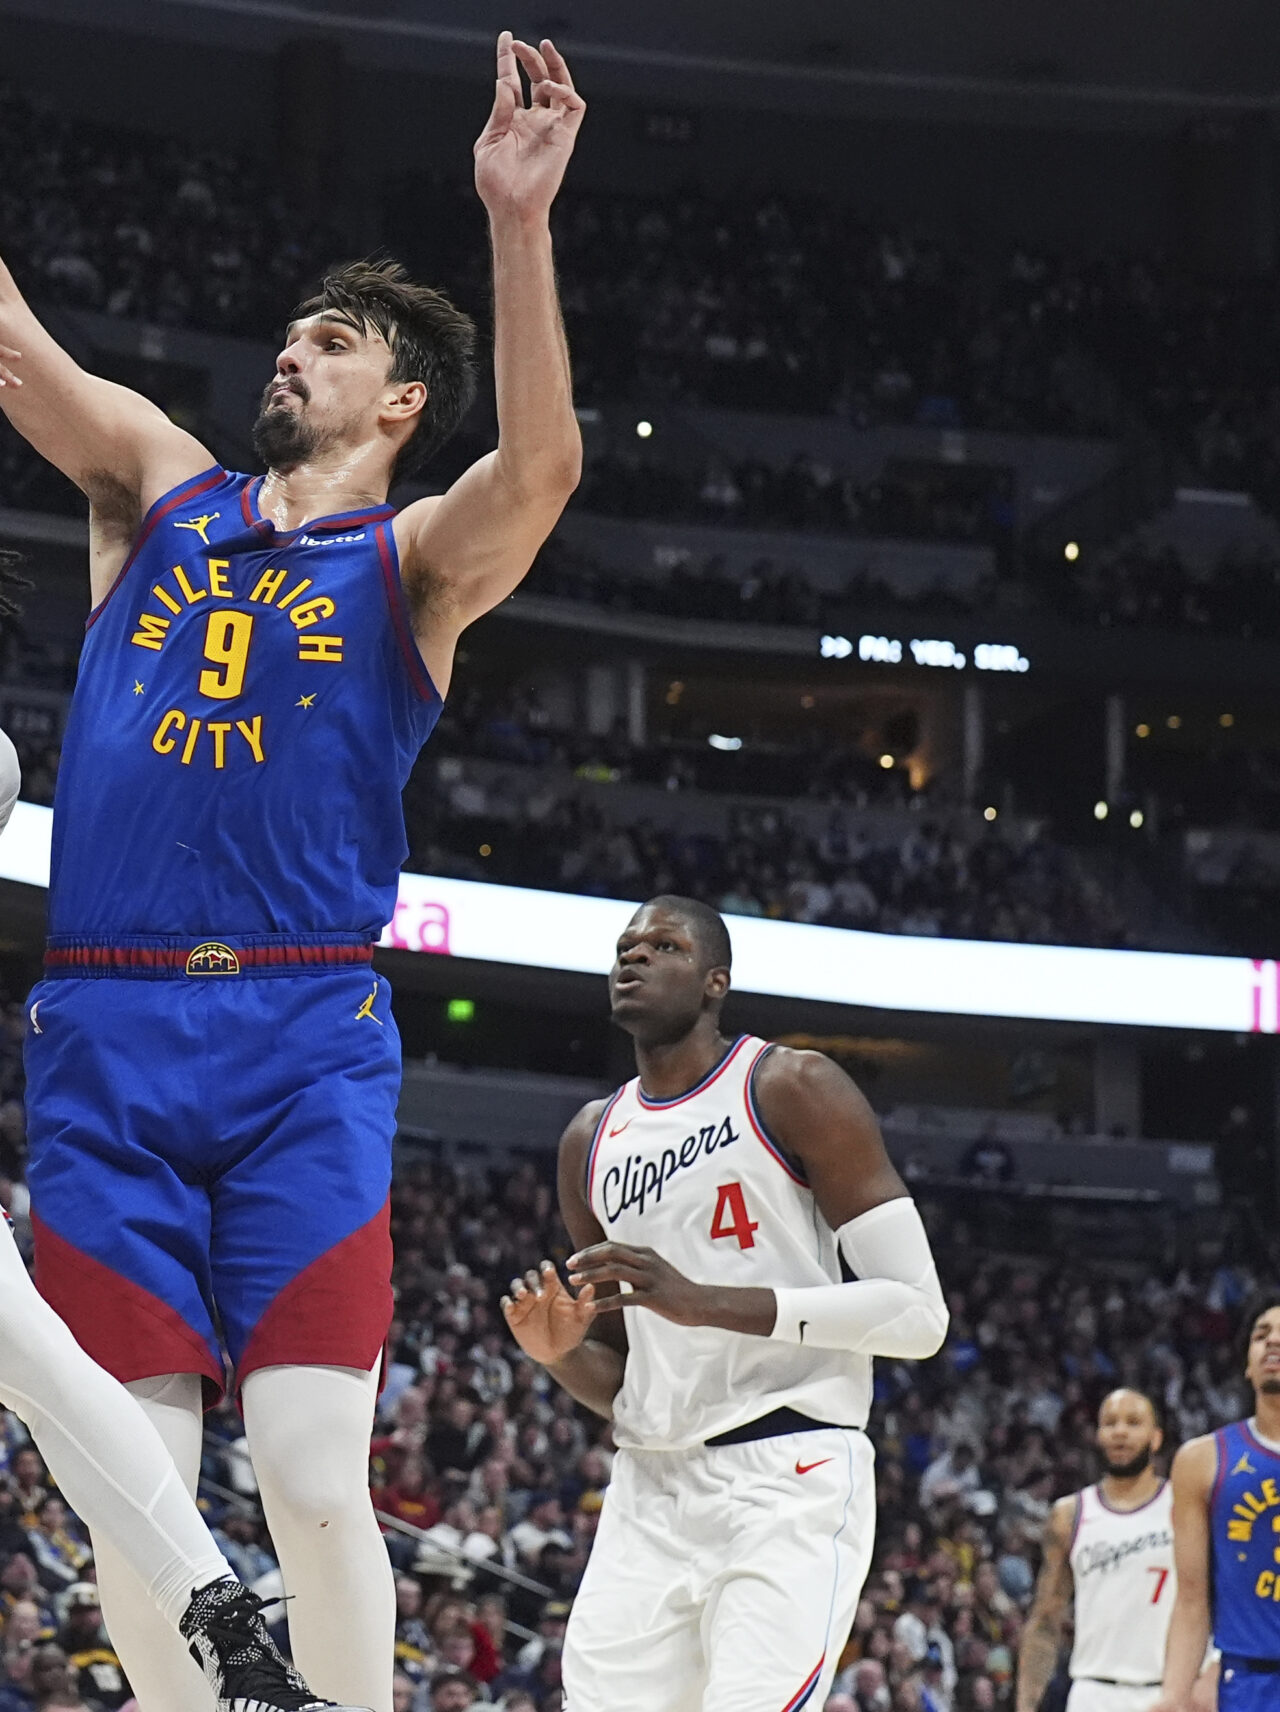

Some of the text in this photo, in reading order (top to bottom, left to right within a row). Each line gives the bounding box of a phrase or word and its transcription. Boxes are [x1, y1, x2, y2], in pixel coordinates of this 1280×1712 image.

[300, 532, 365, 546] ibotta
[131, 559, 343, 662] MILE HIGH
[199, 610, 253, 699] 9
[152, 709, 265, 769] CITY
[603, 1115, 740, 1223] Clippers
[710, 1182, 758, 1250] 4
[1147, 1566, 1169, 1604] 7
